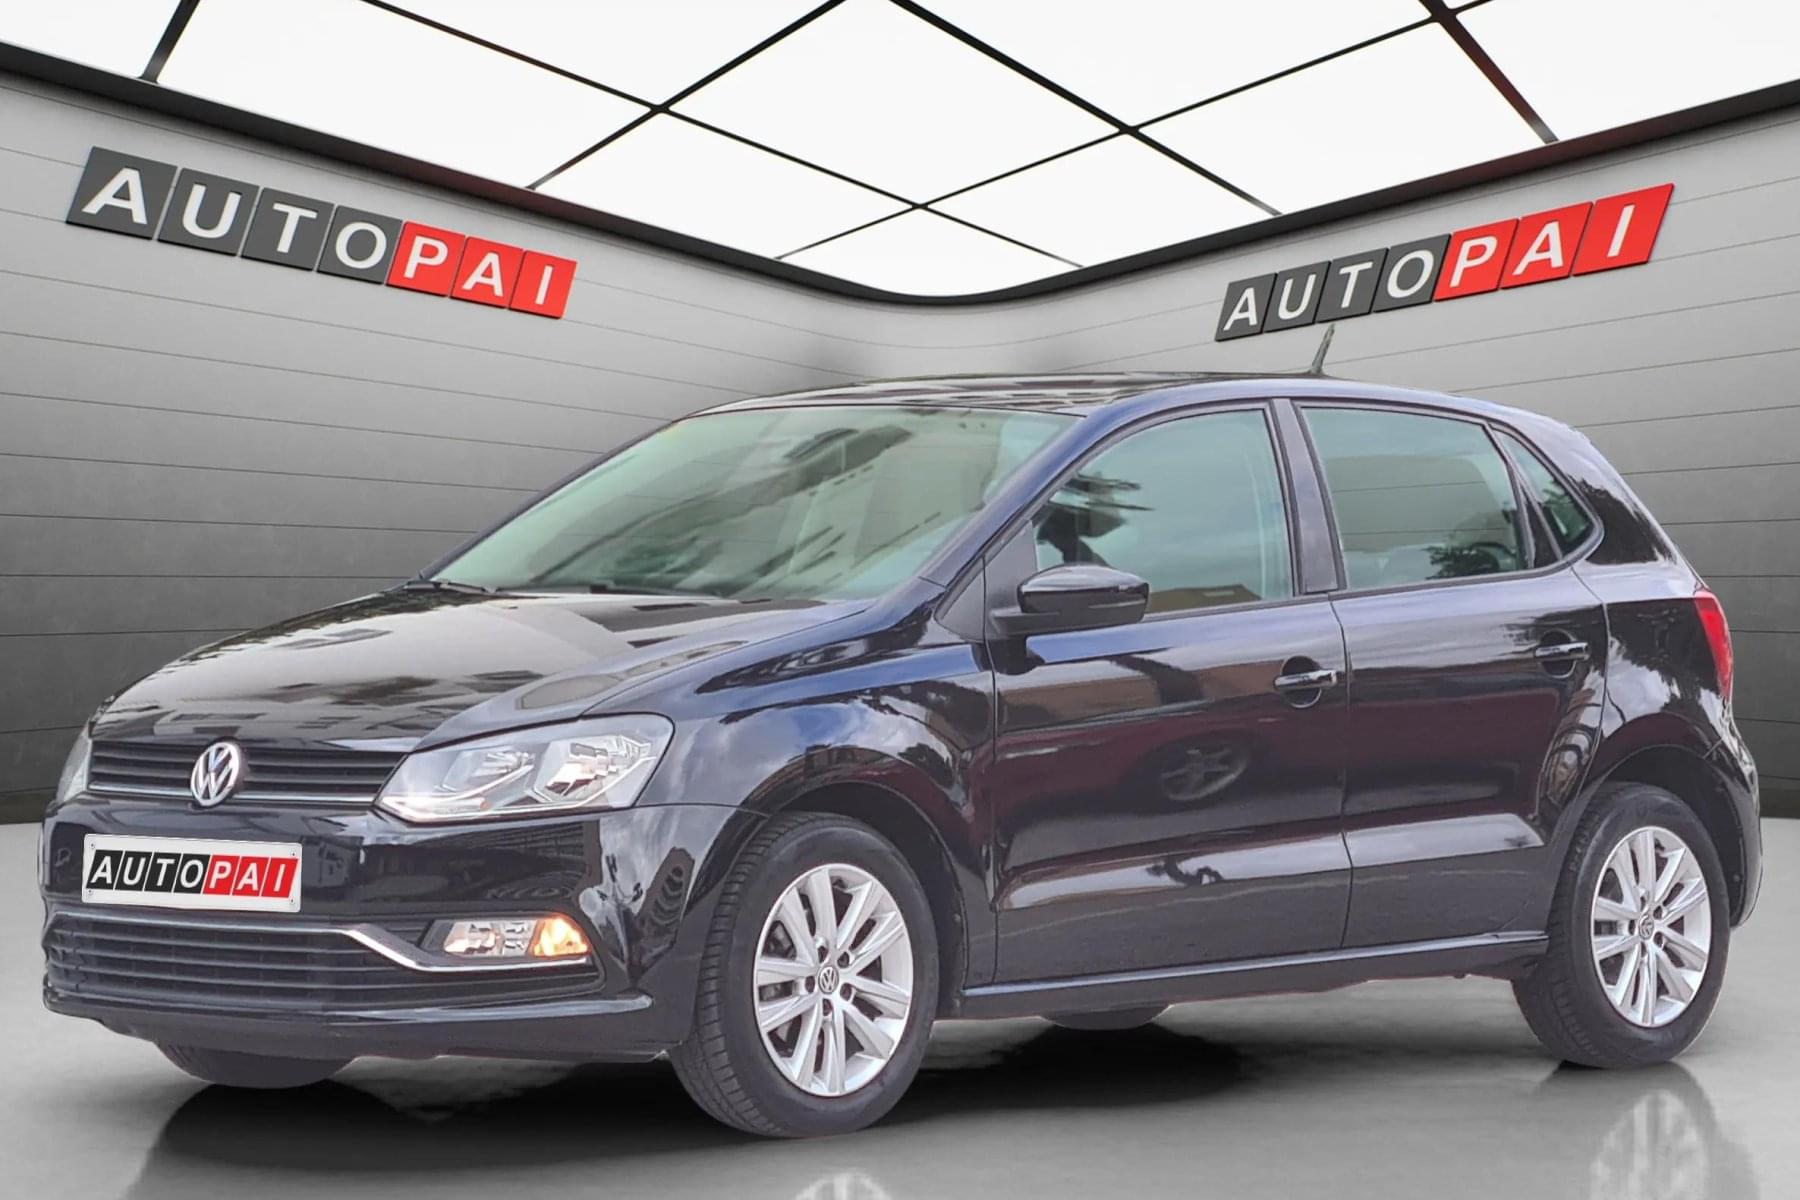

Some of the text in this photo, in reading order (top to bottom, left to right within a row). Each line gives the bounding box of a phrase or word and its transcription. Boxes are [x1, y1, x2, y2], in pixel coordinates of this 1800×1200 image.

[82, 168, 553, 305] AUTOPAI
[1223, 204, 1636, 331] AUTOPAI
[191, 742, 239, 806] VW
[90, 854, 285, 891] AUTOPAI
